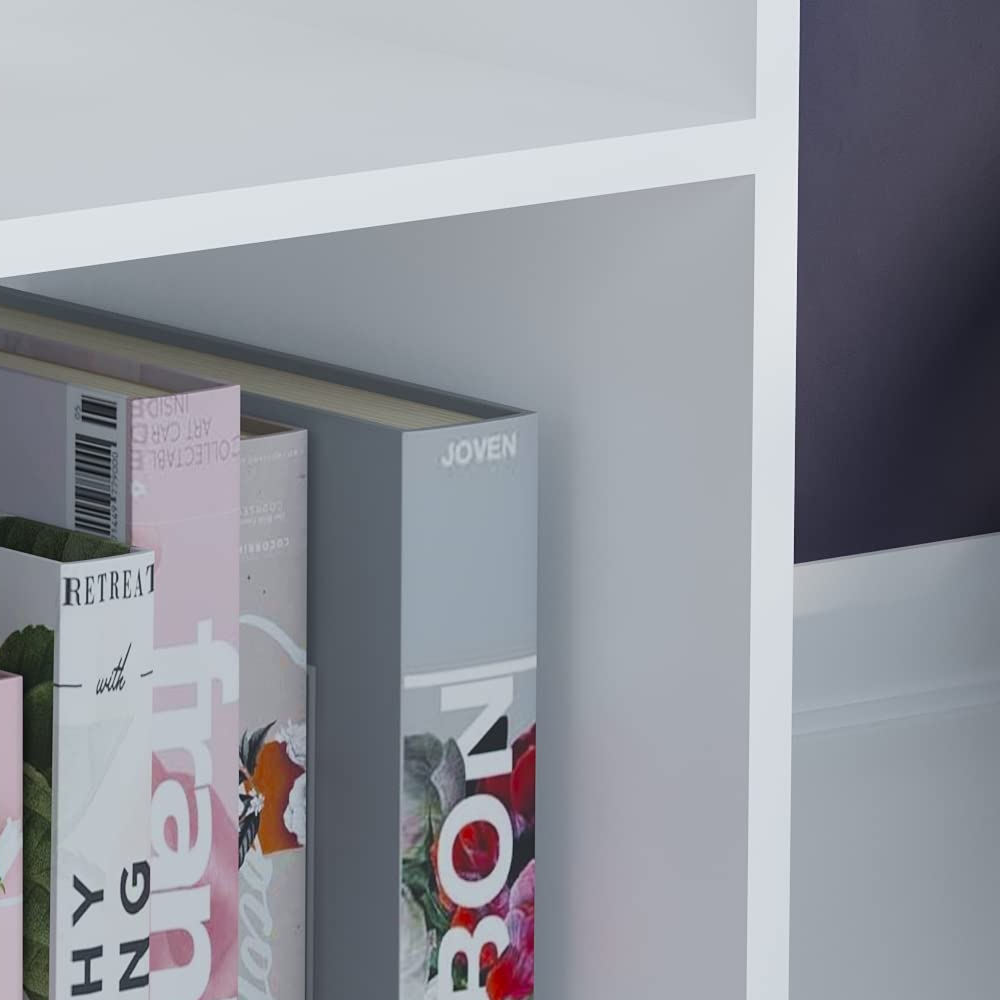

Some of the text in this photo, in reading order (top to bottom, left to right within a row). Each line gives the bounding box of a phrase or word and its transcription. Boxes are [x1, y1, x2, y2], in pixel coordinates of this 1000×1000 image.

[188, 417, 213, 441] ART
[441, 431, 517, 467] JOVEN
[96, 642, 132, 695] with
